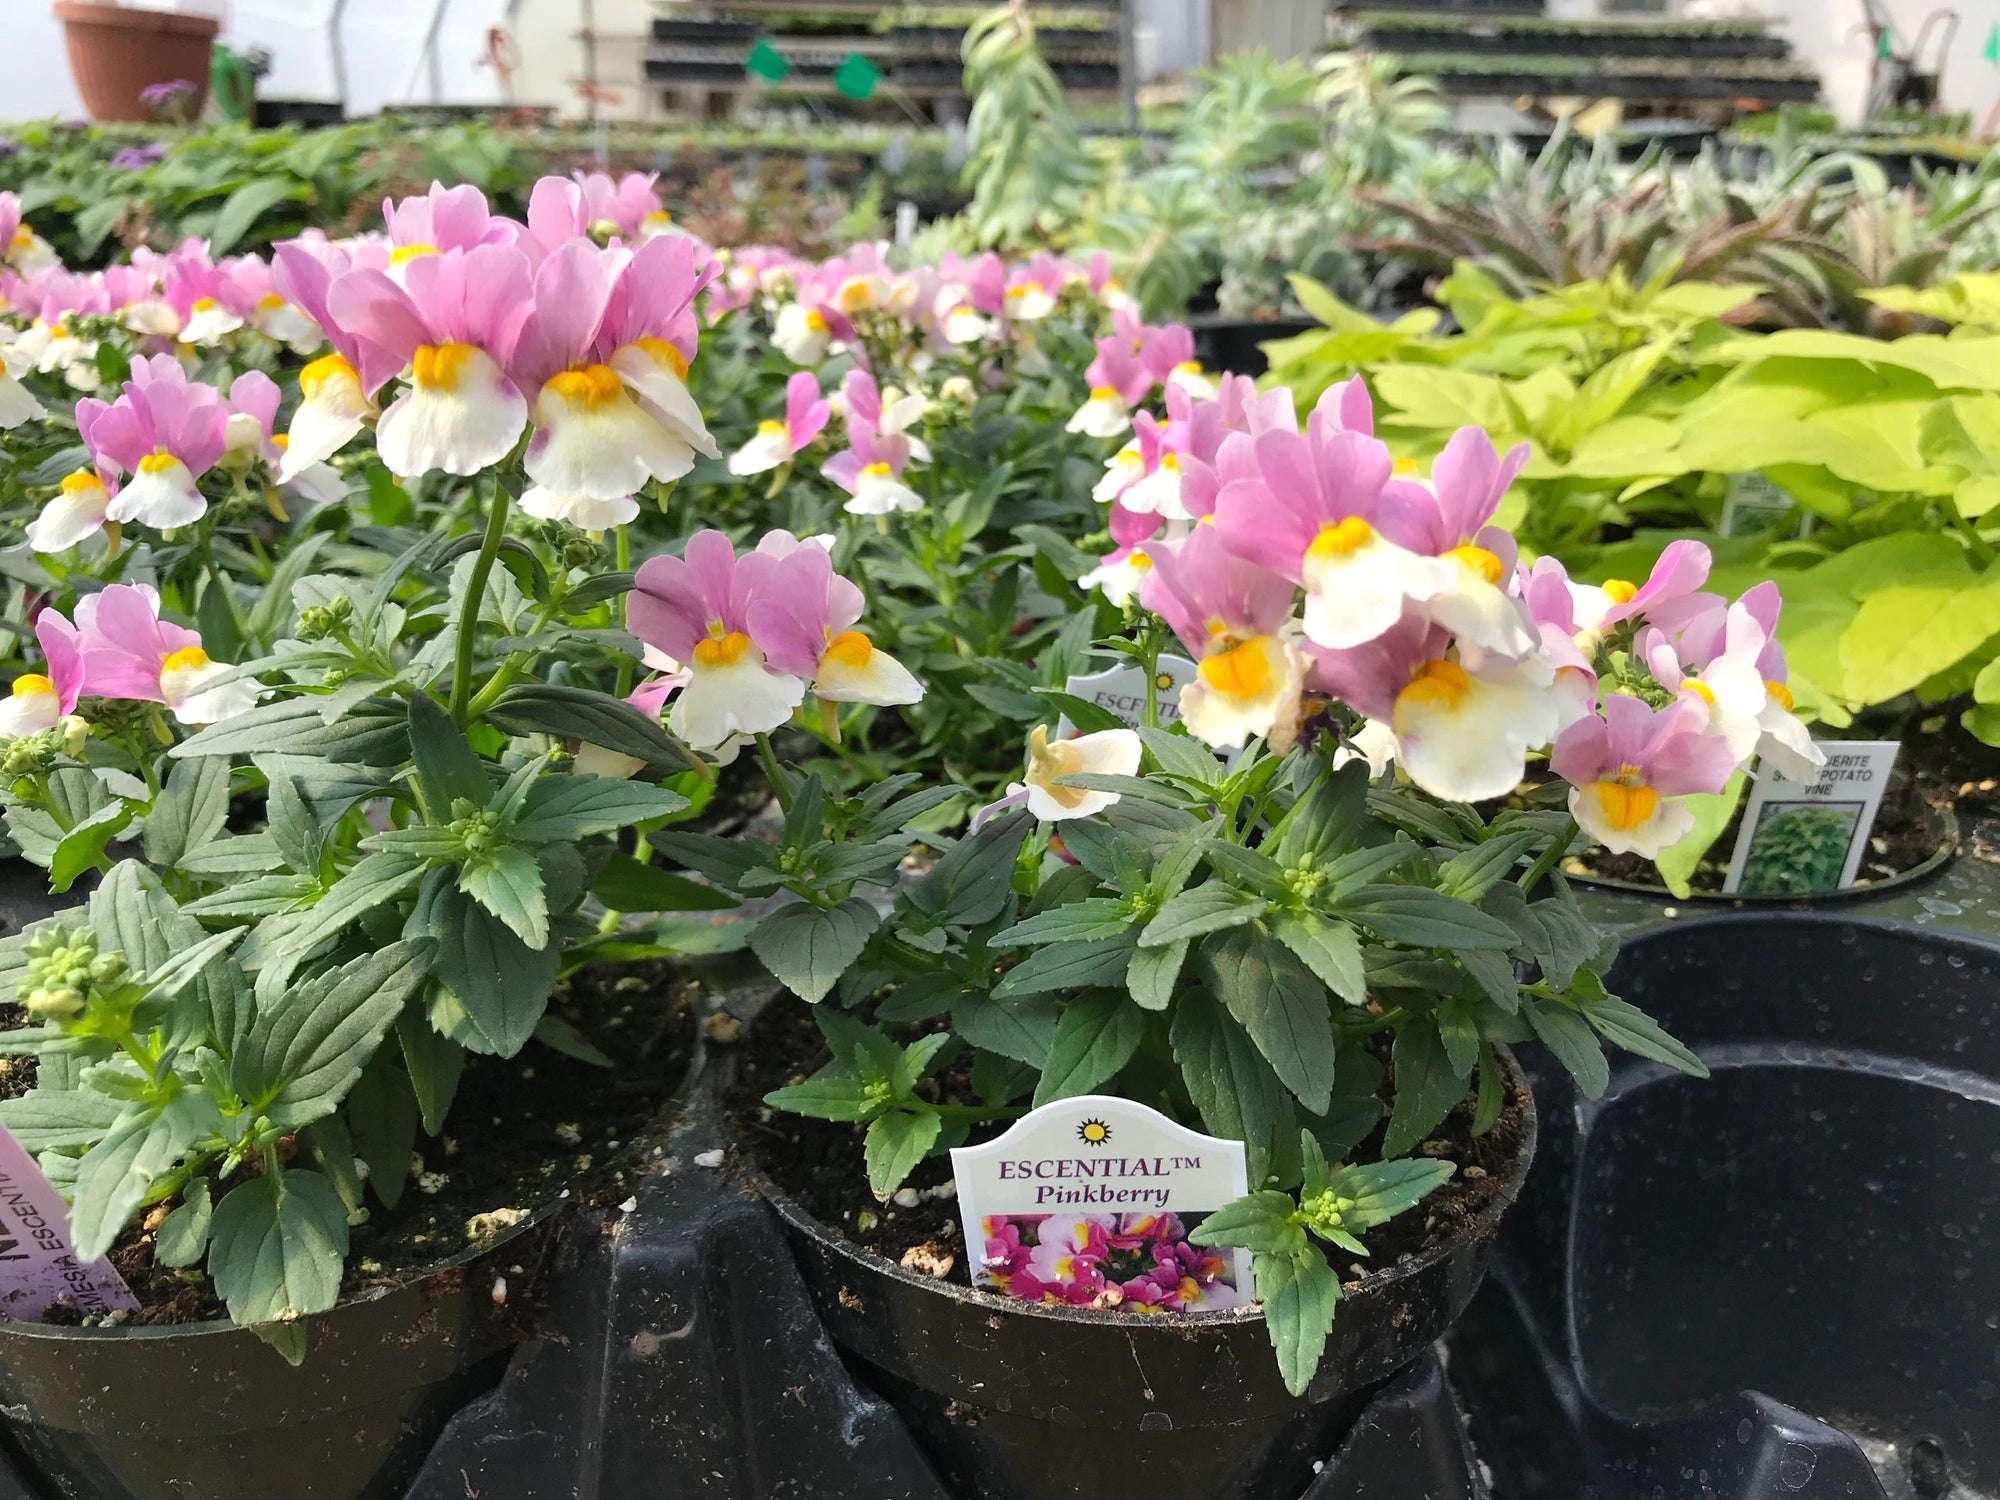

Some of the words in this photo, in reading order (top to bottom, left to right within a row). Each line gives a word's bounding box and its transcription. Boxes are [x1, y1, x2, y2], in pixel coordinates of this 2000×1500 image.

[1095, 691, 1183, 719] ESCETI
[1824, 755, 1871, 767] UERITE
[1820, 769, 1873, 782] POTATO
[1804, 784, 1834, 796] VINE
[998, 1156, 1202, 1180] ESCENTIAL™
[1034, 1184, 1171, 1208] Pinkberry
[0, 1173, 64, 1251] ESCENTI
[52, 1254, 103, 1312] MESIA
